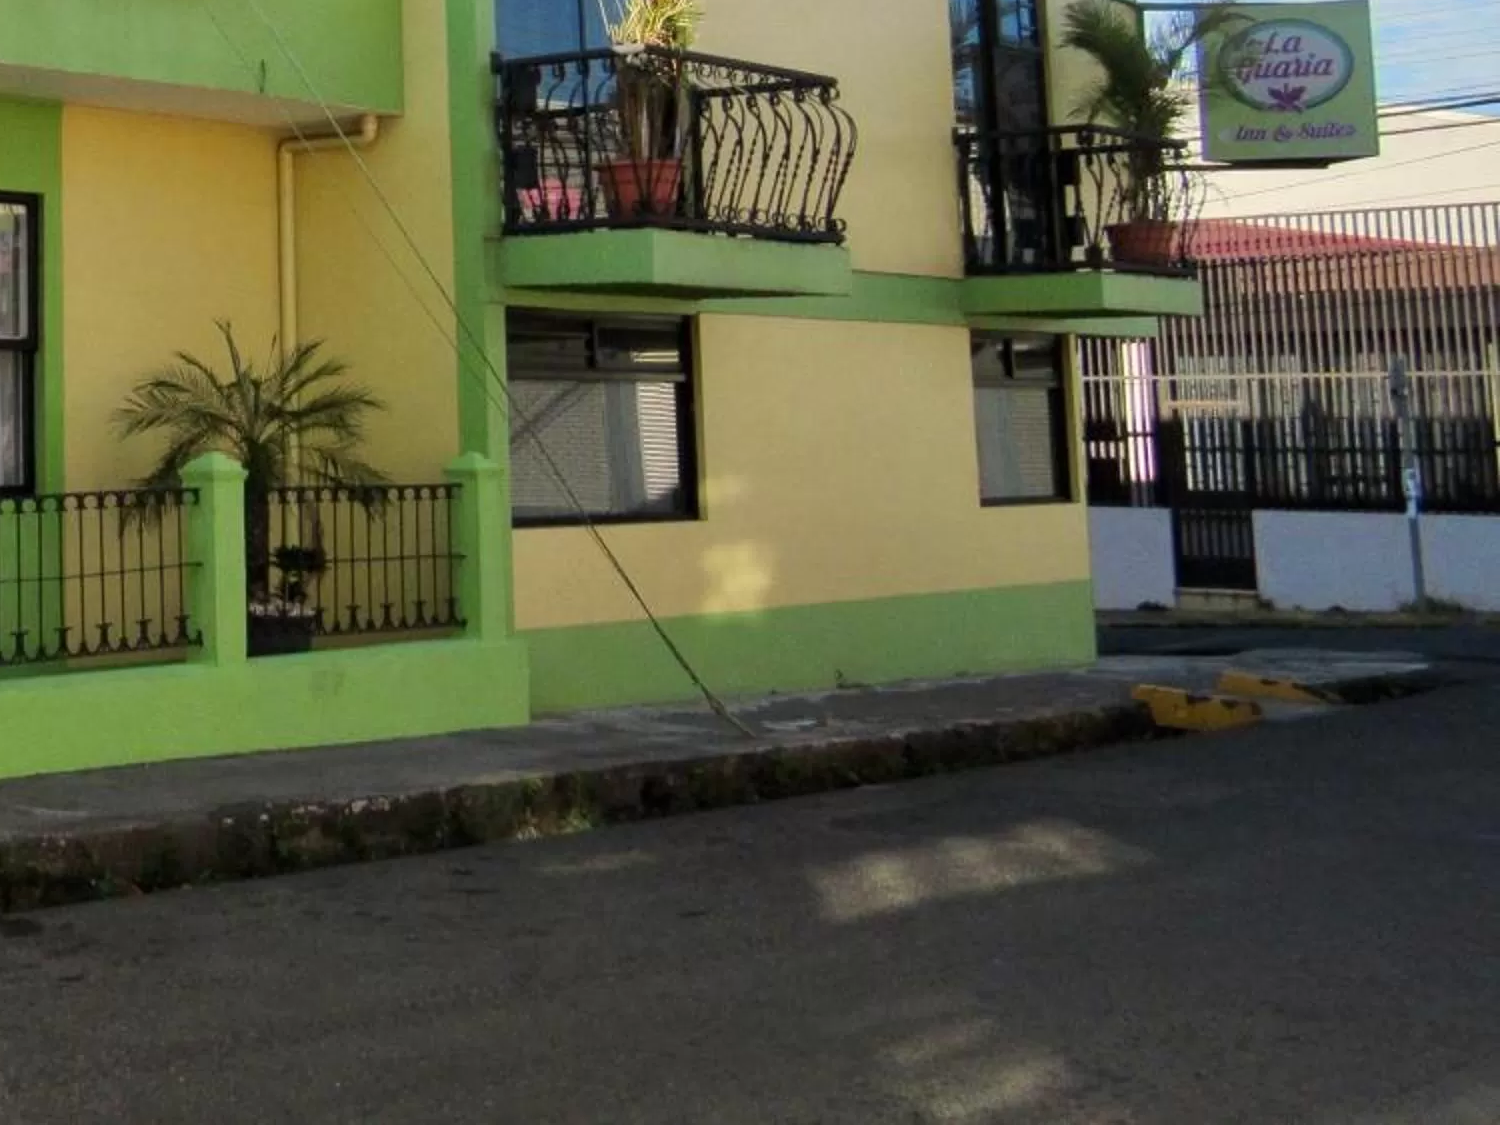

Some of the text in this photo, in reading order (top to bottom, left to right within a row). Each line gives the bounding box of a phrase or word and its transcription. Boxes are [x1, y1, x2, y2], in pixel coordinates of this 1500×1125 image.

[1263, 30, 1304, 56] La
[1235, 122, 1358, 143] Inn & Suites
